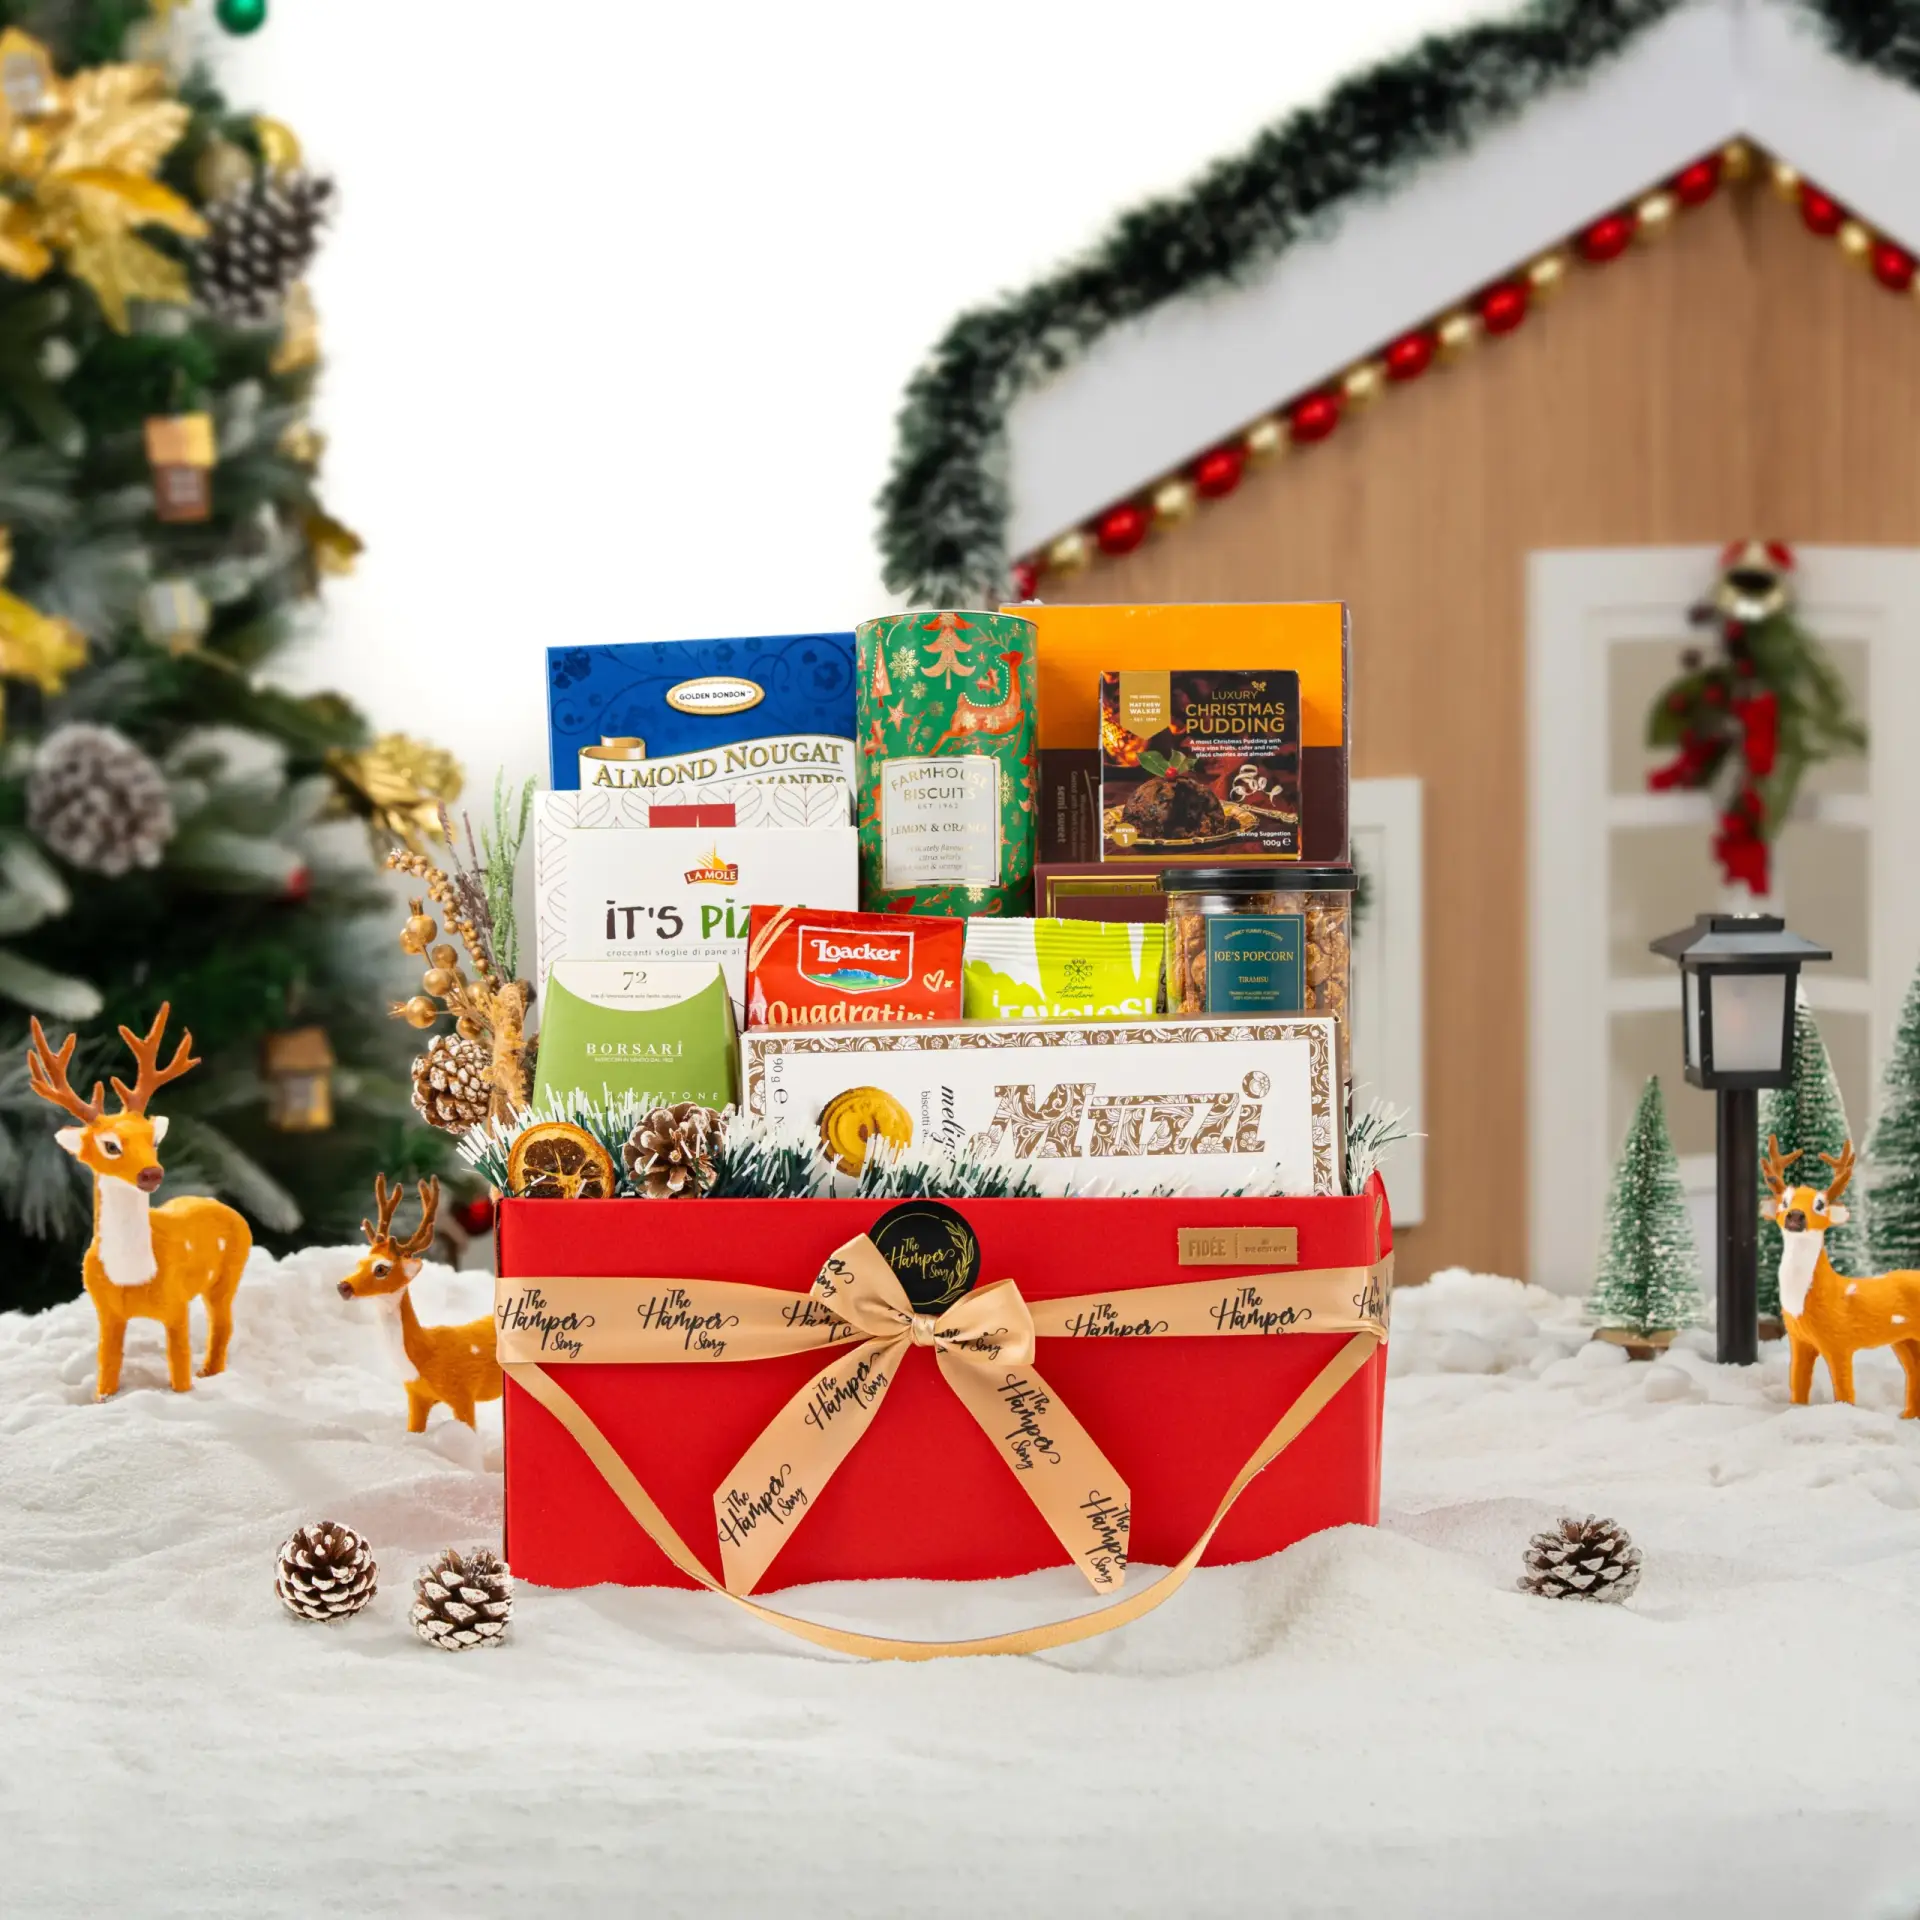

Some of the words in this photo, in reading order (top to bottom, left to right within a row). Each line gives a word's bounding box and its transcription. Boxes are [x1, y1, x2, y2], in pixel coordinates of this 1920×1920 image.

[679, 692, 710, 700] GOLDEN
[712, 691, 746, 699] BONBON
[1212, 691, 1258, 700] LUXURY
[1185, 703, 1285, 717] CHRISTMAS
[1185, 718, 1285, 734] PUDDING
[592, 758, 717, 789] ALMOND
[723, 742, 844, 774] NOUGAT
[904, 787, 976, 800] BISCUITS
[1057, 785, 1068, 809] semi
[930, 823, 939, 832] &
[1057, 812, 1067, 843] sweet
[1122, 834, 1129, 844] 1
[1262, 840, 1282, 848] 100g
[687, 871, 702, 882] LA
[704, 870, 736, 881] MOLE
[606, 948, 652, 956] croccanti
[655, 947, 688, 957] sfoglie
[692, 947, 701, 956] di
[704, 948, 728, 957] pane
[731, 947, 741, 956] al
[810, 939, 901, 963] Loacker
[1214, 951, 1240, 962] JOE'S
[1243, 951, 1293, 961] POPCORN
[623, 971, 647, 991] 72
[773, 1058, 784, 1073] 90
[921, 1090, 932, 1130] biscotti
[902, 1236, 920, 1252] The
[1188, 1236, 1227, 1257] FIDÉE
[884, 1245, 956, 1280] Hamper
[522, 1288, 547, 1309] The
[666, 1288, 692, 1309] The
[1236, 1287, 1263, 1307] The
[497, 1296, 596, 1350] Hamper
[637, 1296, 740, 1350] Hamper
[1065, 1307, 1169, 1337] Hamper
[1092, 1303, 1119, 1321] The
[1209, 1294, 1312, 1335] Hamper
[550, 1332, 584, 1358] Story
[694, 1332, 727, 1358] Story
[804, 1352, 881, 1430] Hamper
[814, 1376, 838, 1399] The
[1032, 1387, 1052, 1415] The
[997, 1373, 1061, 1465] Hamper
[717, 1464, 793, 1548] Hamper
[723, 1489, 750, 1513] The
[1114, 1502, 1130, 1533] The
